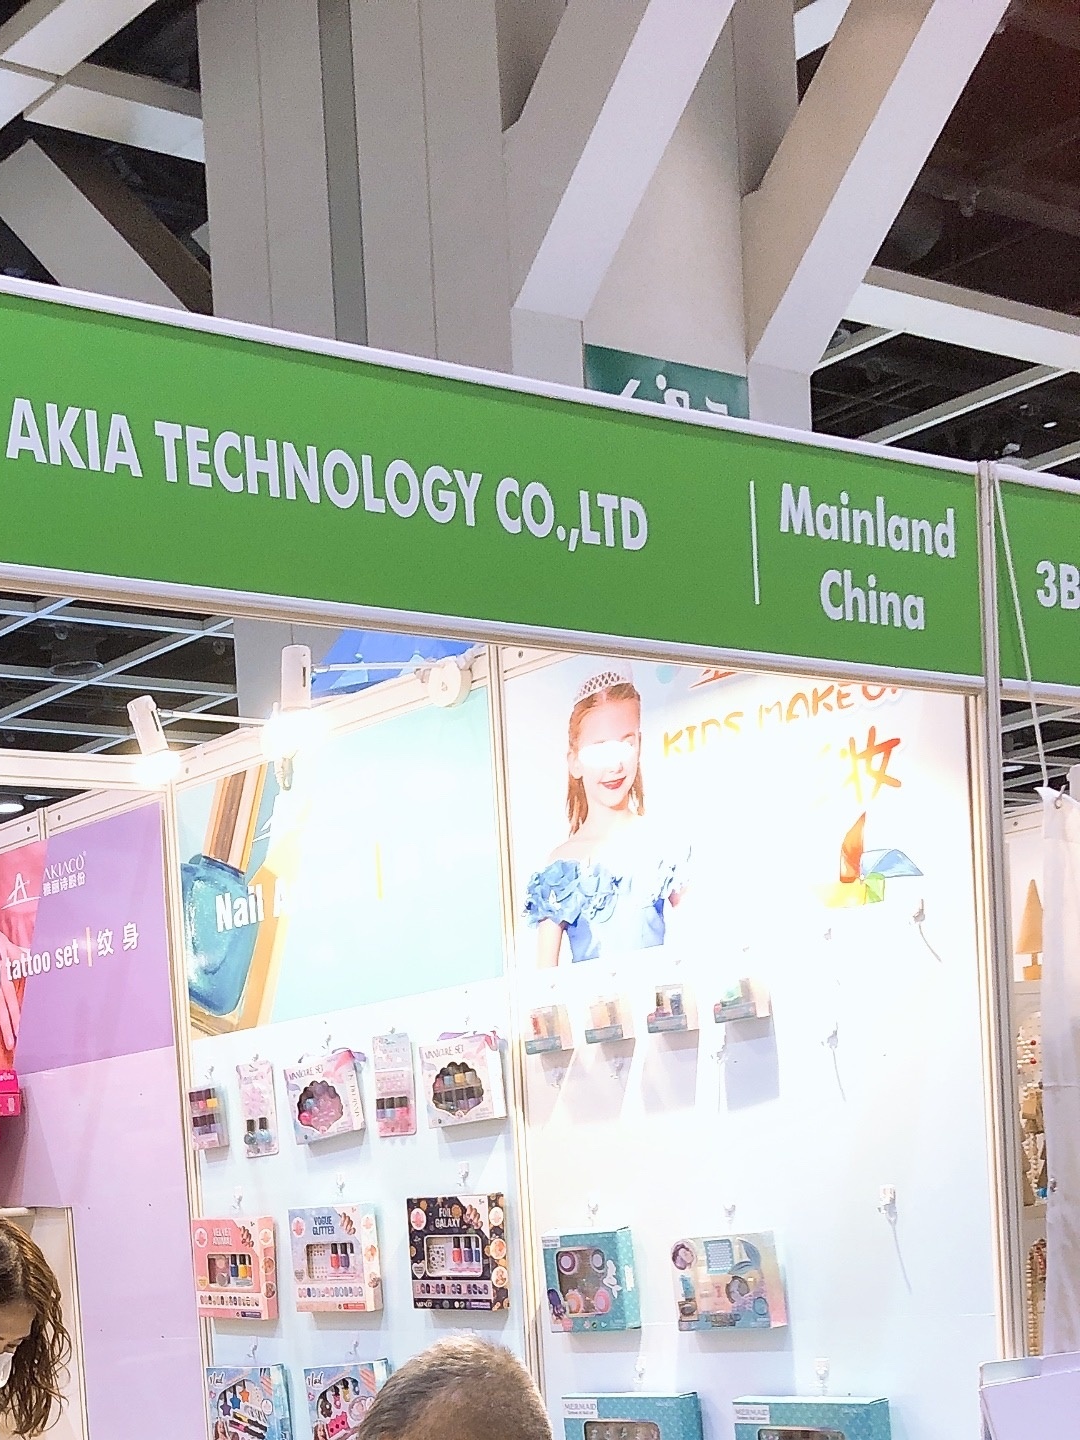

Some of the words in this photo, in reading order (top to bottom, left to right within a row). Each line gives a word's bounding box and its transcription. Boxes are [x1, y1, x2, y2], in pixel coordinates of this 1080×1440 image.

[6, 397, 143, 478] AKIA
[155, 420, 483, 528] TECHNOLOGY
[496, 477, 649, 553] CO.,LTD
[780, 483, 956, 558] Mainland
[820, 569, 925, 631] China
[214, 883, 265, 934] Nail
[6, 949, 51, 981] tattoo
[55, 938, 80, 970] set
[96, 921, 140, 957] 纹身
[313, 1216, 333, 1226] VOGUE
[435, 1218, 461, 1228] GALAXY
[438, 1207, 452, 1218] FOIL
